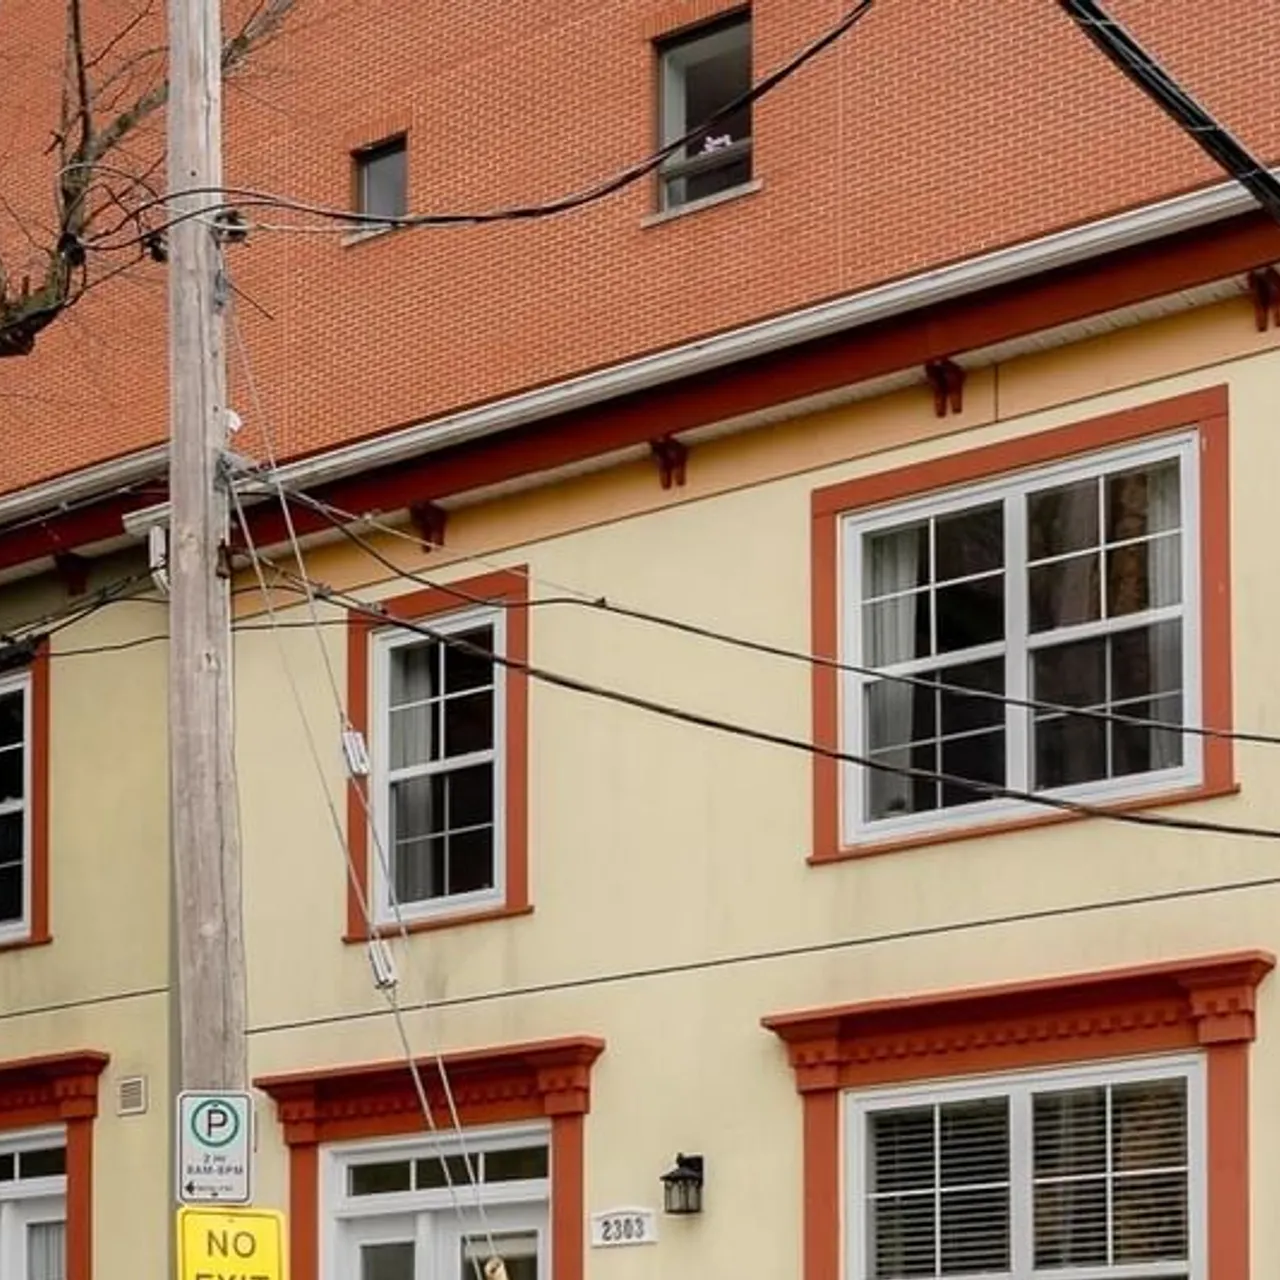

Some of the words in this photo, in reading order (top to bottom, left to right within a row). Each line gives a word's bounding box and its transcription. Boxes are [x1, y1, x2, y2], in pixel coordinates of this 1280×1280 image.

[207, 1109, 228, 1137] P
[602, 1217, 644, 1241] 2303
[208, 1230, 256, 1258] NO
